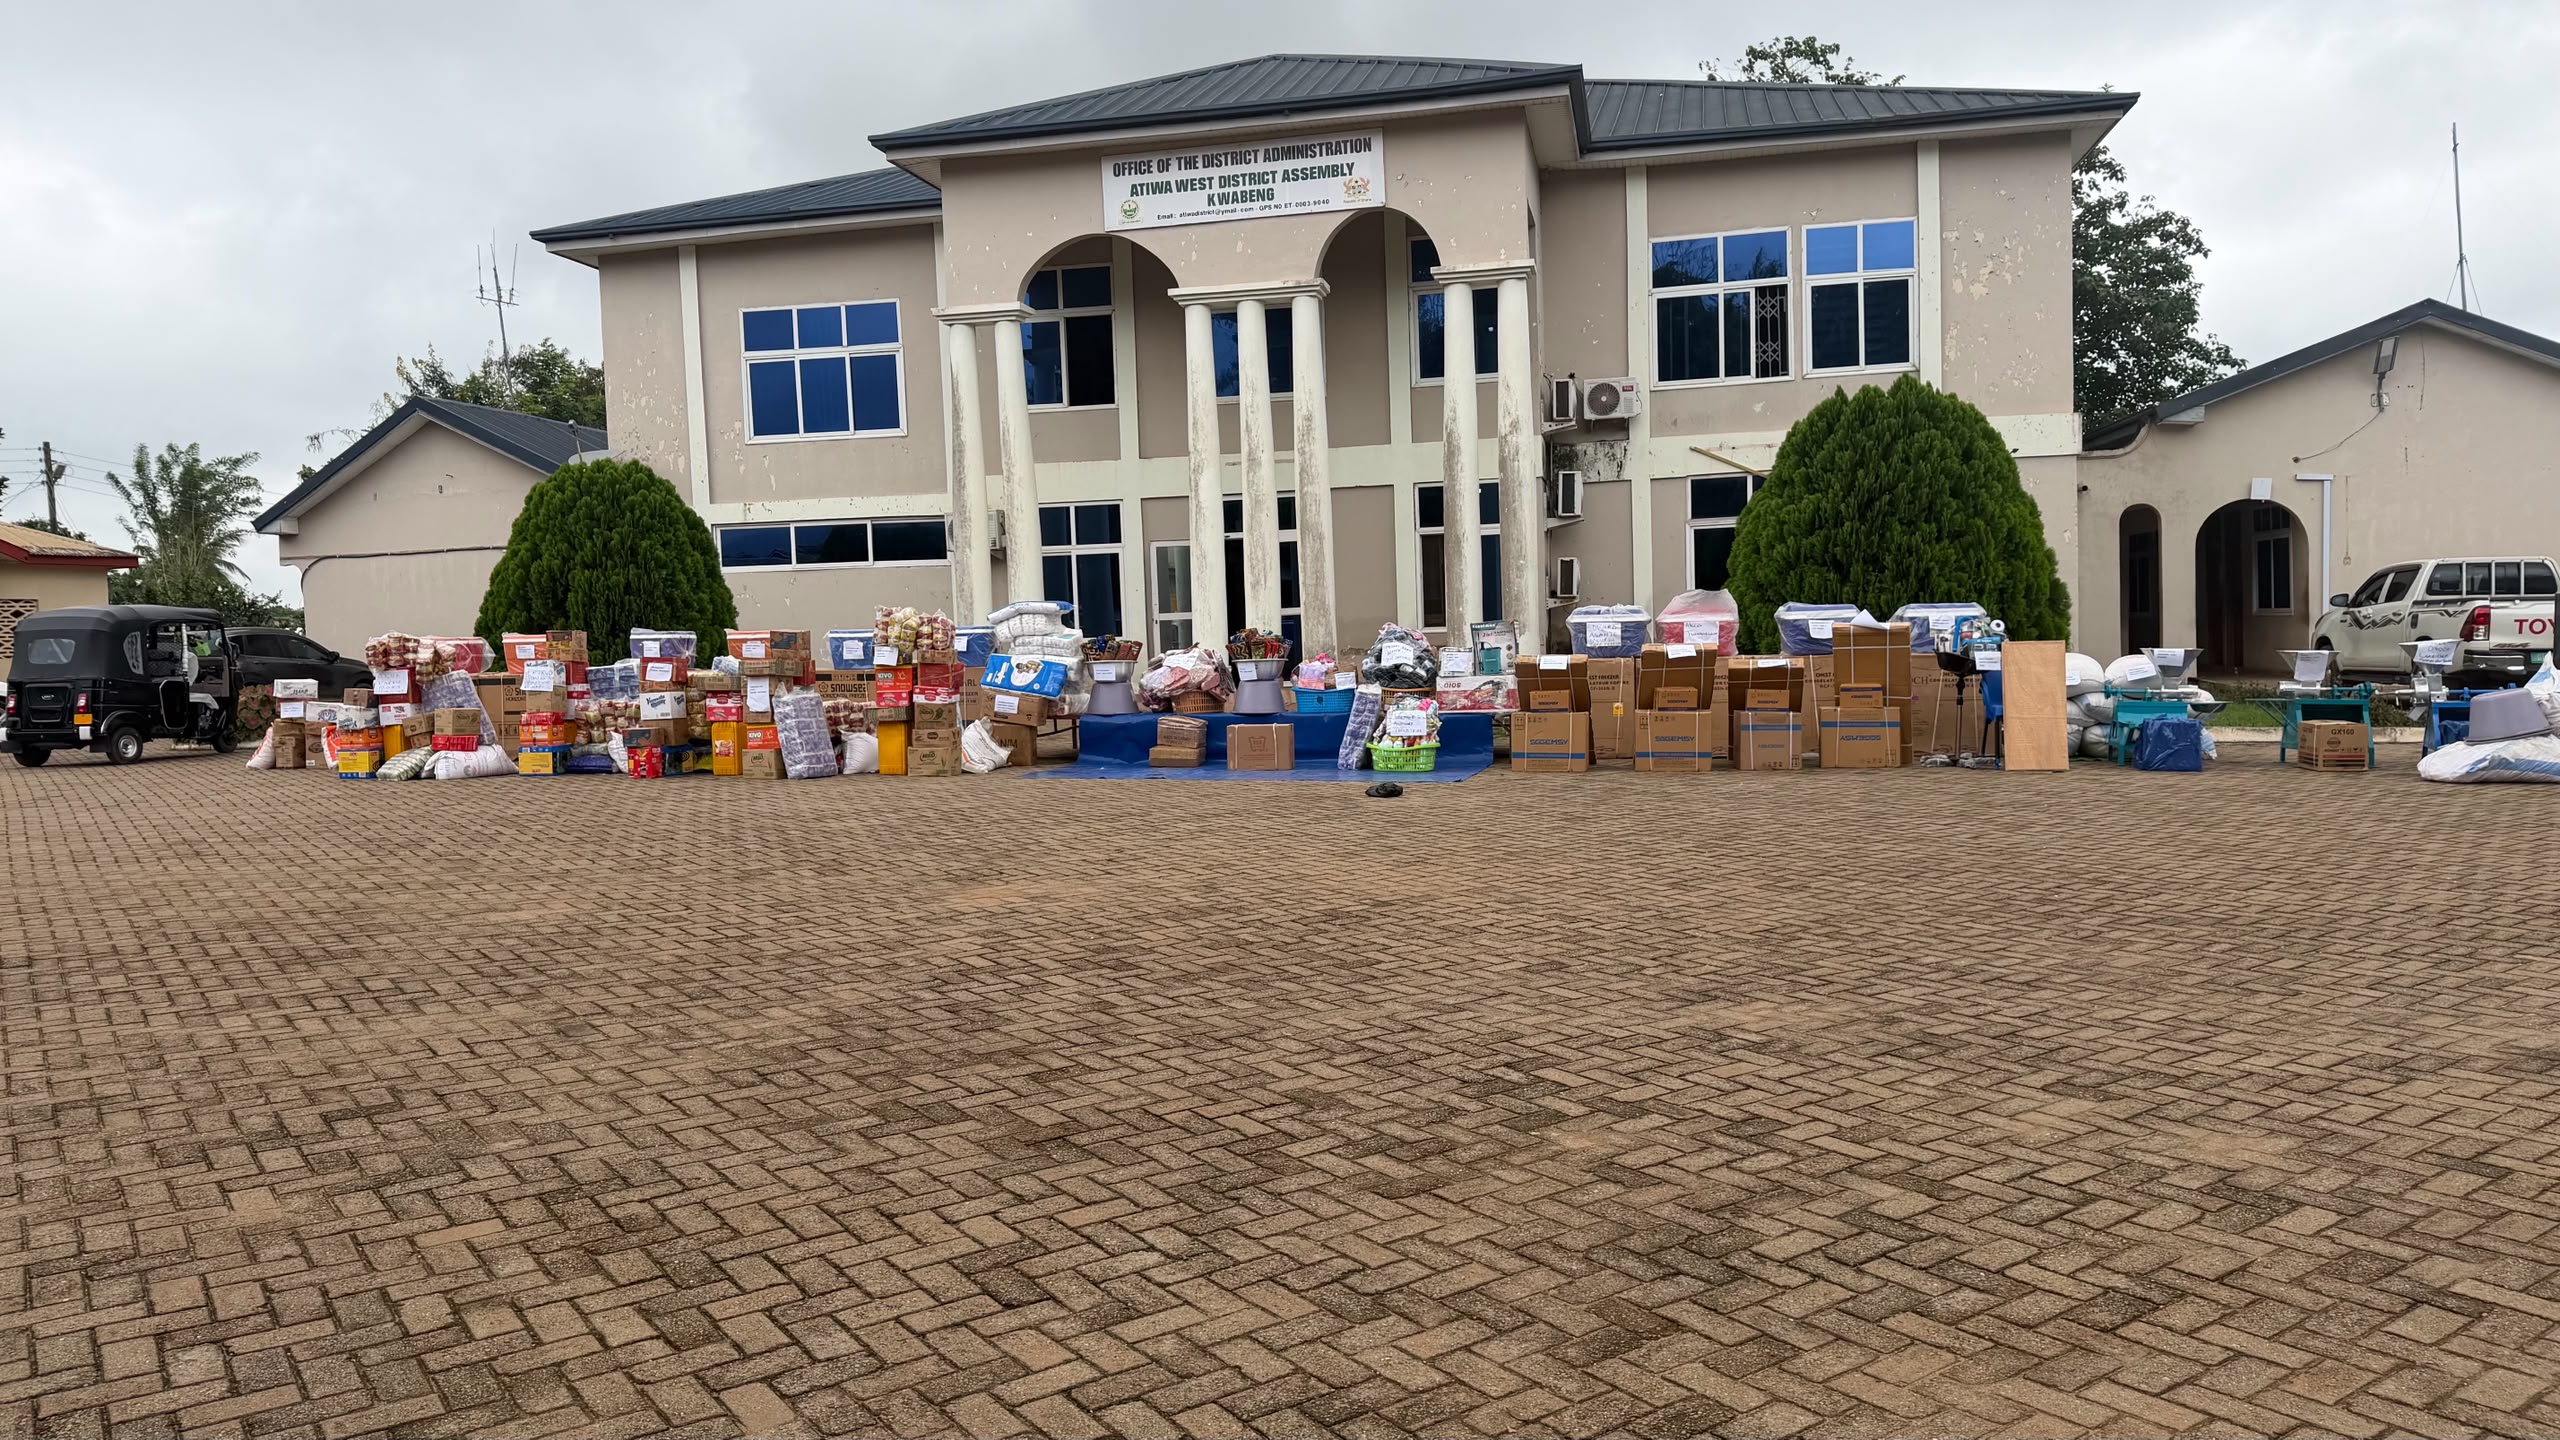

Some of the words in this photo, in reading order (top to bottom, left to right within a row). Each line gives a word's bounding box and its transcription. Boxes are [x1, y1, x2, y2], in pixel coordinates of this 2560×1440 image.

[1112, 159, 1154, 178] OFFICE
[1156, 157, 1172, 174] OF
[1175, 155, 1199, 171] THE
[1201, 148, 1260, 169] DISTRICT
[1262, 137, 1372, 163] ADMINISTRATION
[1129, 180, 1173, 197] ATIWA
[1174, 176, 1214, 193] WEST
[1218, 170, 1278, 189] DISTRICT
[1281, 162, 1355, 183] ASSEMBLY
[1207, 187, 1275, 207] KWABENG
